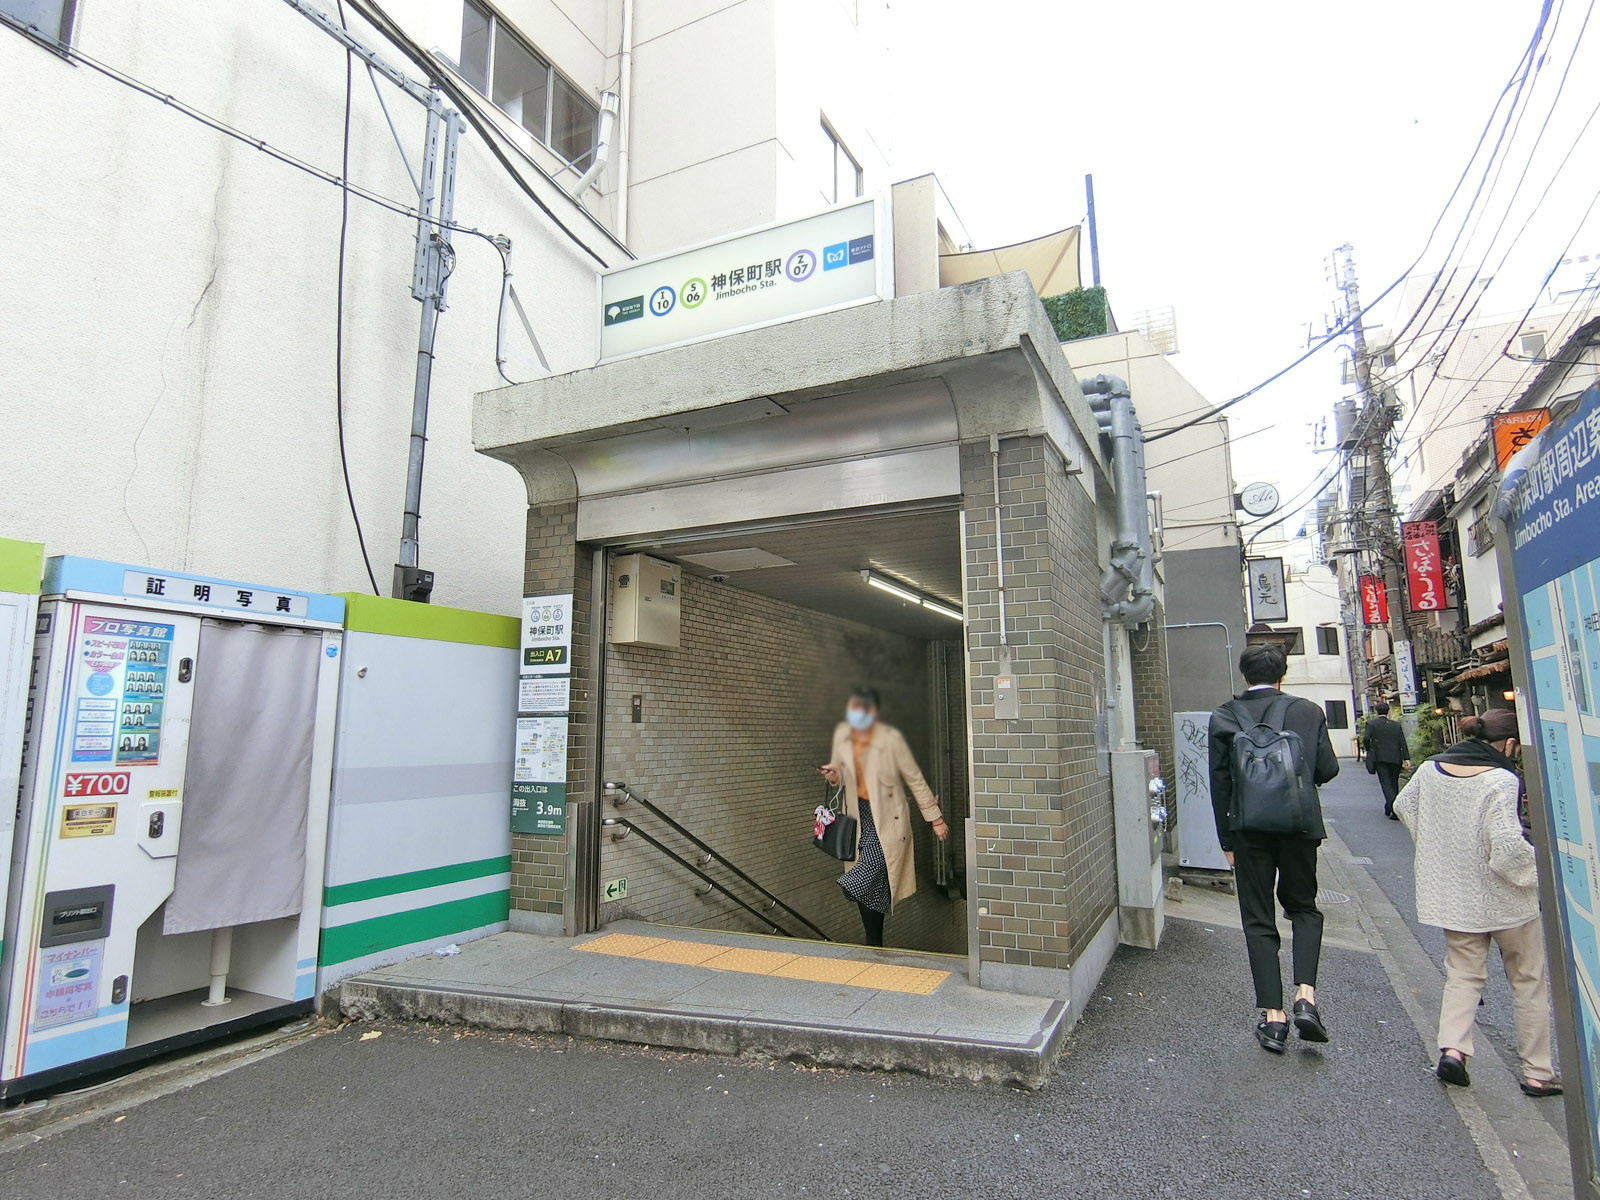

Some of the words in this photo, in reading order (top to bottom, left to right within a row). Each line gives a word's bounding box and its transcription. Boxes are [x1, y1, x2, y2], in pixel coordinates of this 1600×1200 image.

[798, 255, 804, 264] Z
[711, 258, 782, 292] 神保町駅
[793, 264, 808, 275] 07
[691, 283, 696, 292] S
[716, 283, 757, 301] Jimbocho
[760, 280, 777, 289] Sta.
[661, 291, 665, 299] I
[686, 292, 700, 303] 06
[658, 300, 669, 310] 10
[1515, 511, 1552, 550] Jimbocho
[1553, 499, 1574, 523] Sta.
[146, 577, 291, 613] 証明写真
[91, 620, 168, 638] プロ写真館
[529, 624, 564, 636] 神保町駅
[545, 649, 562, 662] A7
[67, 774, 128, 795] ¥700
[513, 785, 548, 793] この出入口は
[536, 801, 562, 816] 3.9m
[47, 947, 98, 962] マイナンバー
